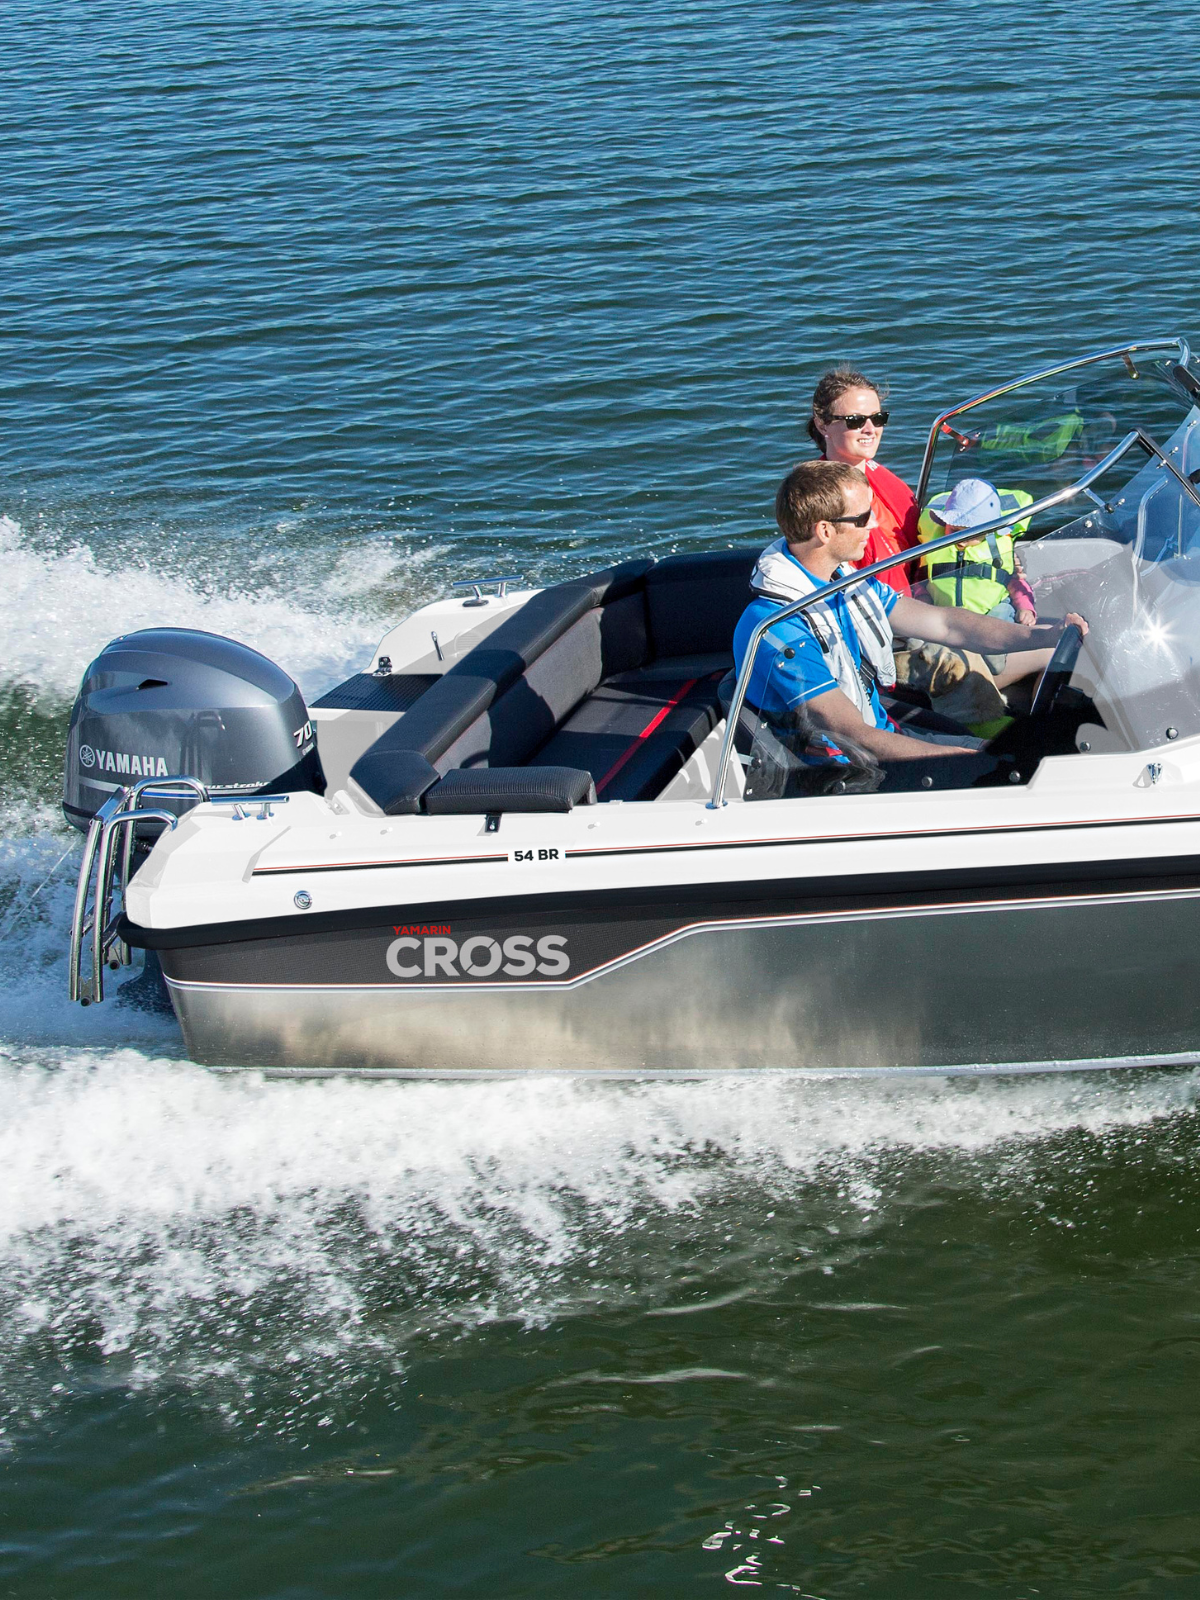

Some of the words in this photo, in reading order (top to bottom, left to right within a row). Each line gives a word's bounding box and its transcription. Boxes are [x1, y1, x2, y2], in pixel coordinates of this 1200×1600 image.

[294, 721, 313, 748] 70
[95, 748, 169, 777] YAMAHA
[514, 850, 534, 862] 54
[538, 848, 560, 861] BR
[393, 925, 451, 935] YAMARIN
[386, 934, 571, 978] CROSS
